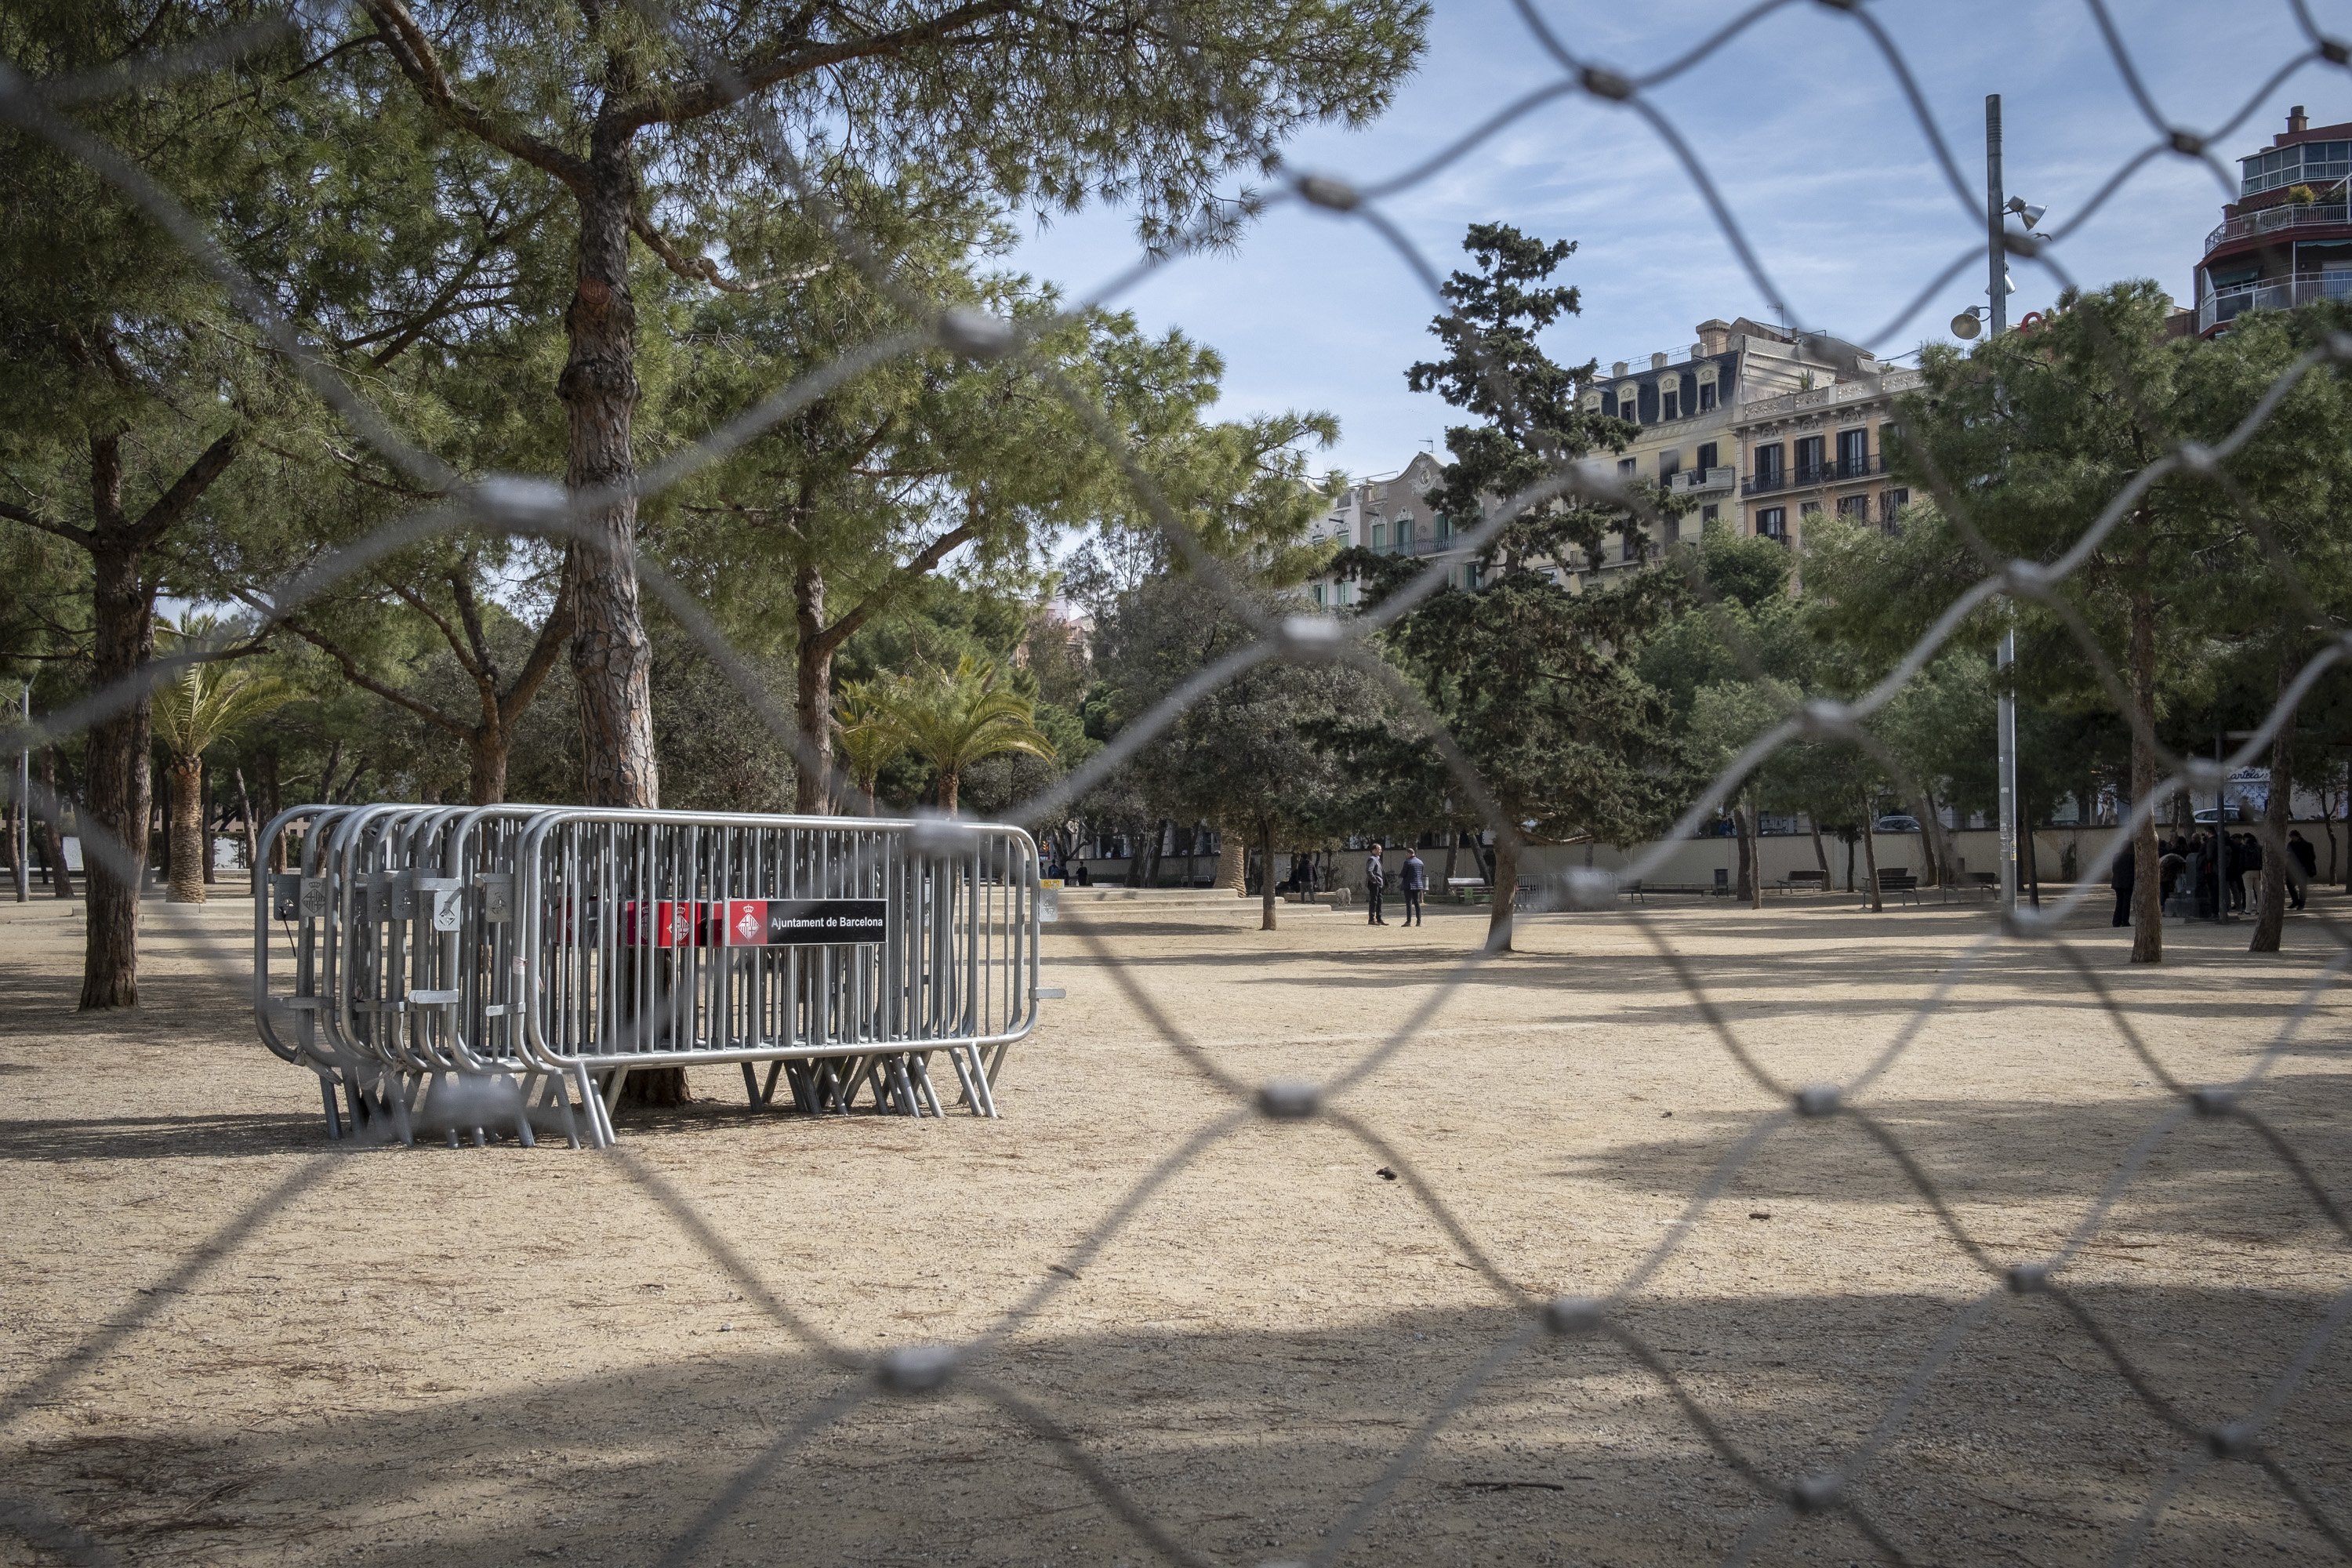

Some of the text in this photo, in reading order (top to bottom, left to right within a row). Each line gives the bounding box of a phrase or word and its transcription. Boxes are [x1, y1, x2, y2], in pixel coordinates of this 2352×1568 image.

[771, 916, 883, 930] Ajuntament de Barcelona
